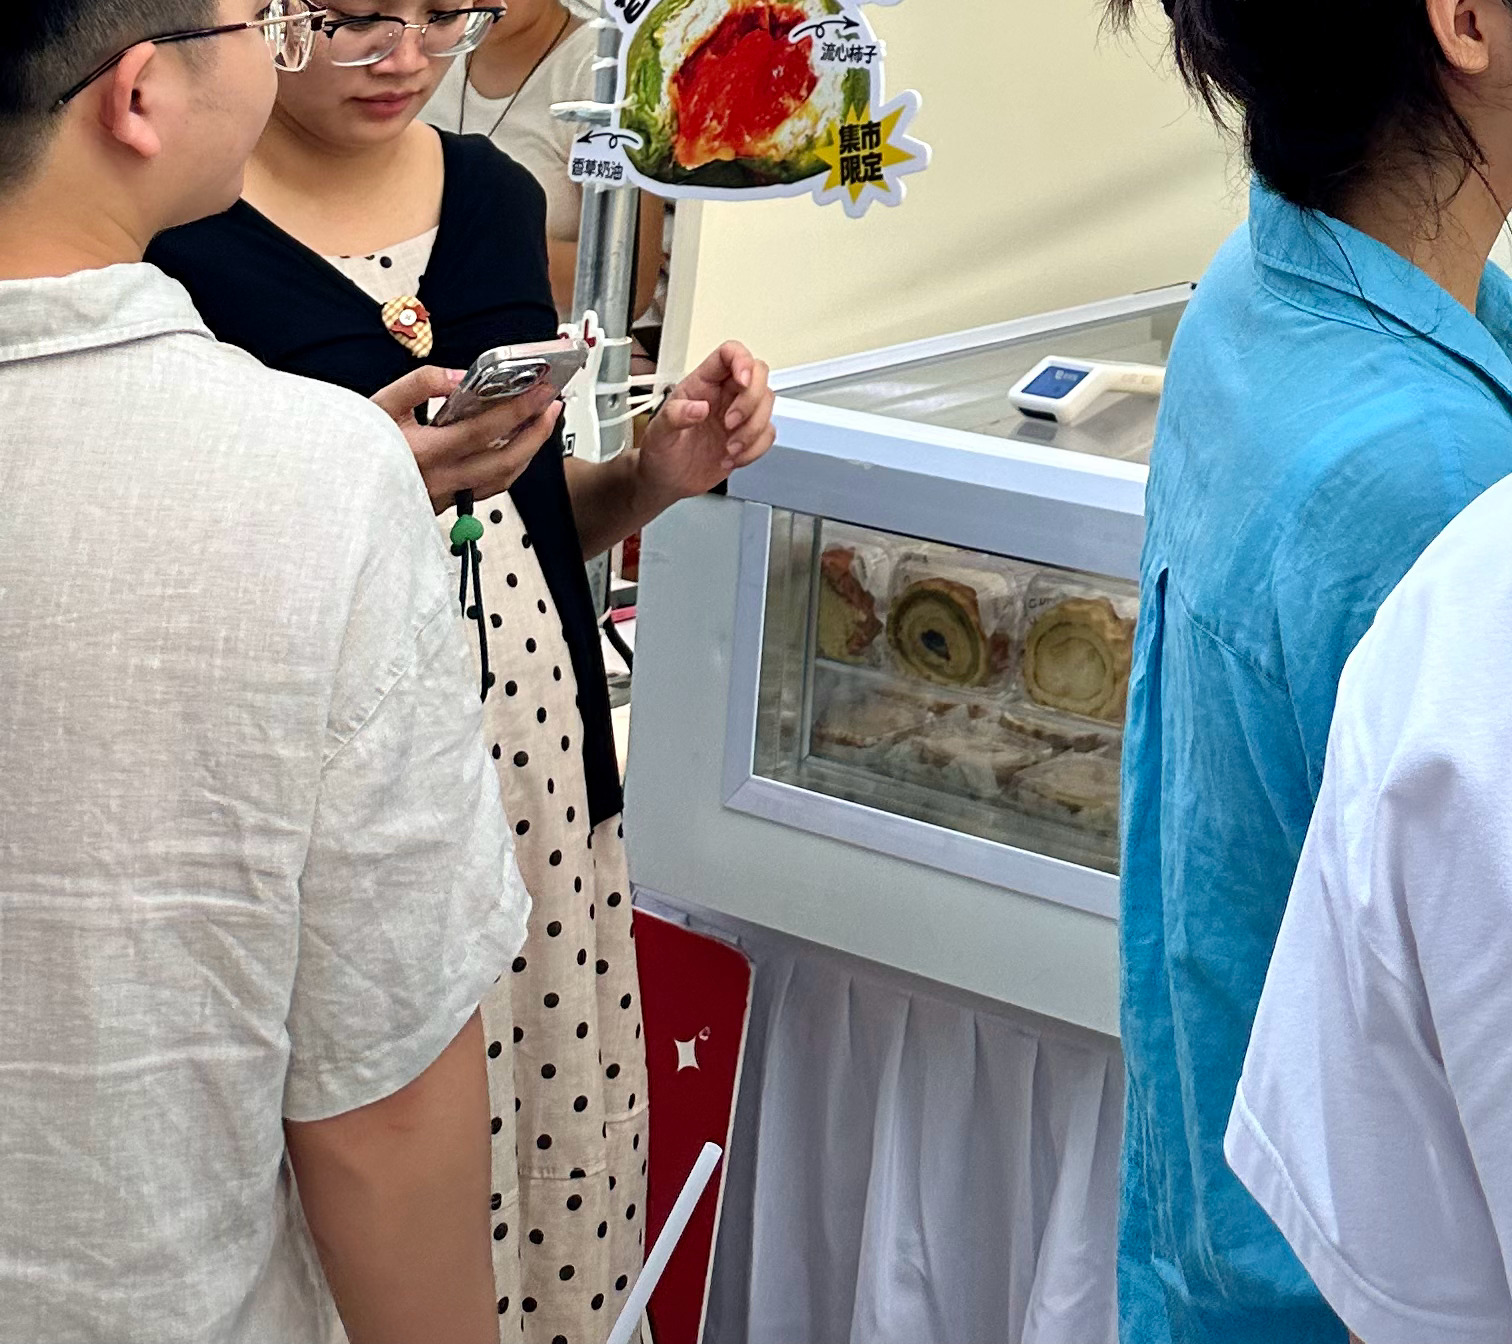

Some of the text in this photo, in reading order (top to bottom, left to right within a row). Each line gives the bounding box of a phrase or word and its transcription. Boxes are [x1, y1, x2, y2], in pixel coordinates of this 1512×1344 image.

[820, 42, 877, 64] 流心柿子
[838, 120, 882, 153] 集市
[572, 157, 623, 180] 香草奶油
[839, 152, 883, 185] 限定
